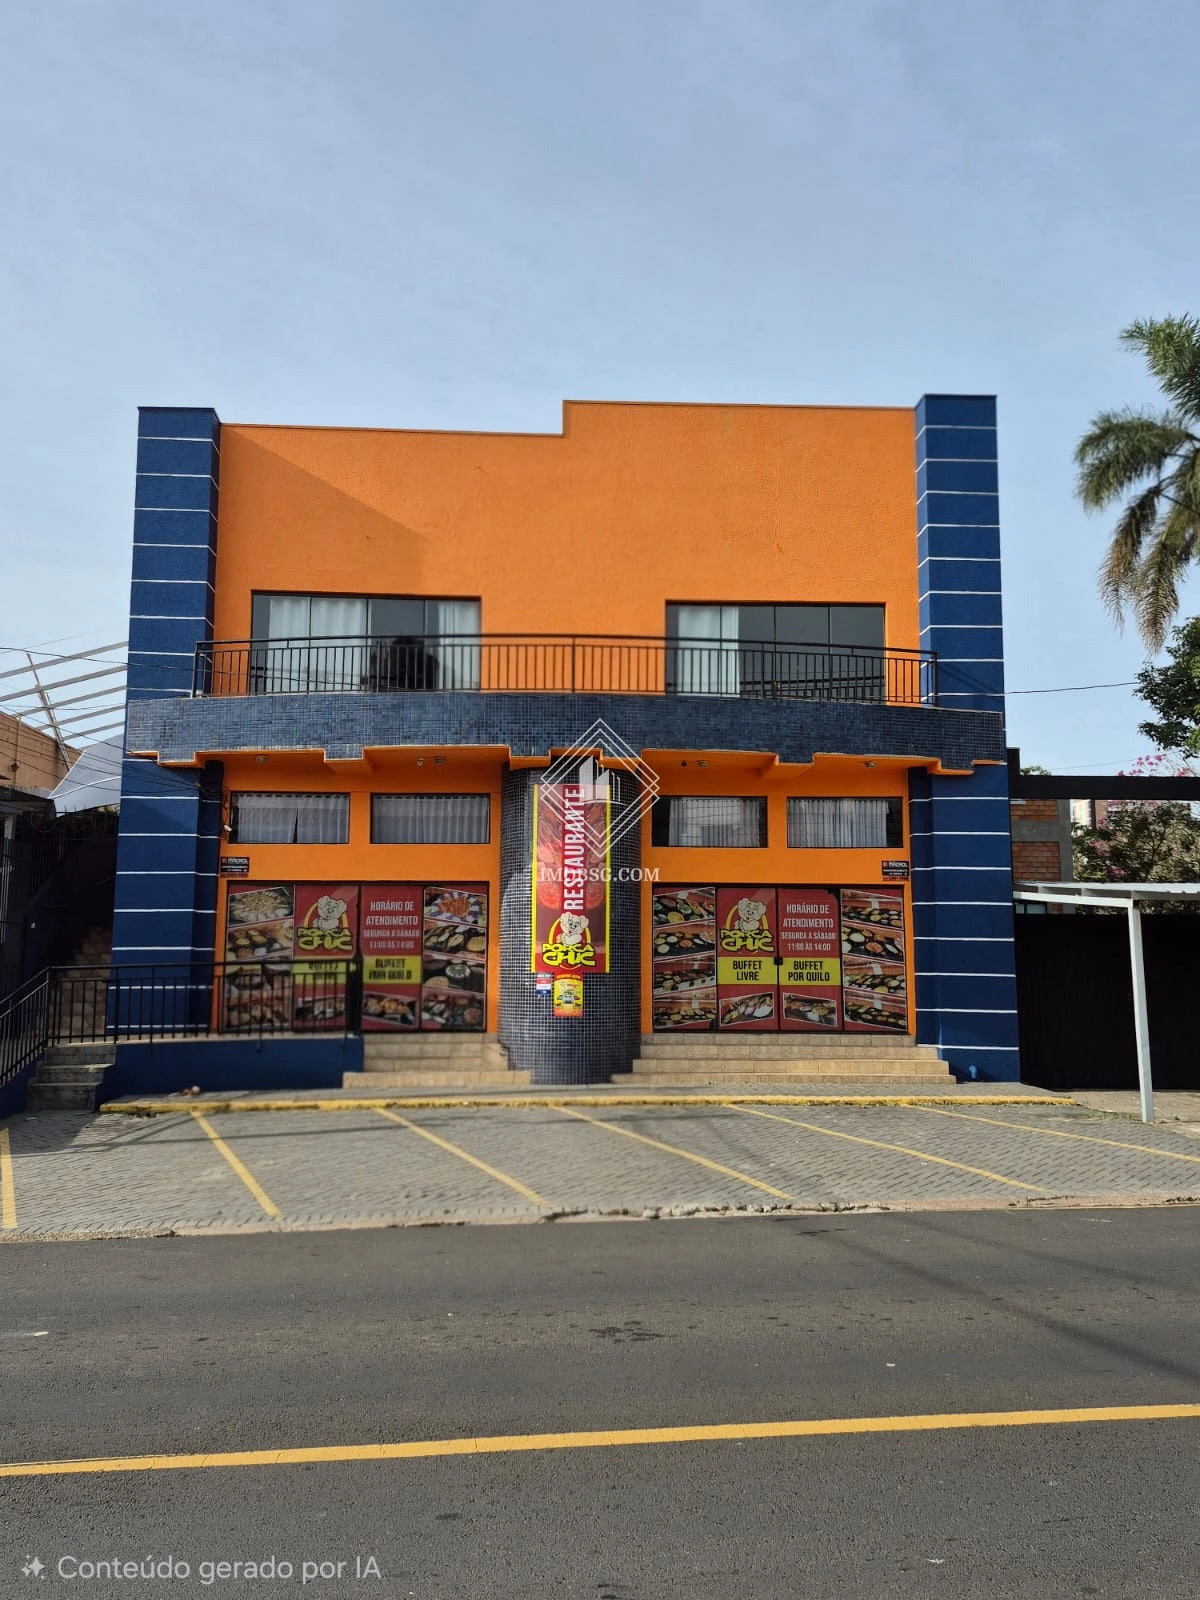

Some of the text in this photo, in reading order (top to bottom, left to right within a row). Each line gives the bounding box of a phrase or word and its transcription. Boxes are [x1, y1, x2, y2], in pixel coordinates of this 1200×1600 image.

[563, 788, 586, 910] RESTAURANTE
[370, 900, 415, 911] HORÁRIO DE
[786, 902, 830, 914] HORÁRIO DE
[366, 916, 418, 925] ATENDIMENTO
[783, 918, 834, 928] ATENDIMENTO
[781, 931, 807, 939] SEGUNDA
[732, 960, 763, 971] BUFFET
[793, 961, 823, 970] BUFFET
[736, 972, 760, 982] LIVRE
[788, 972, 830, 983] POR QUILO
